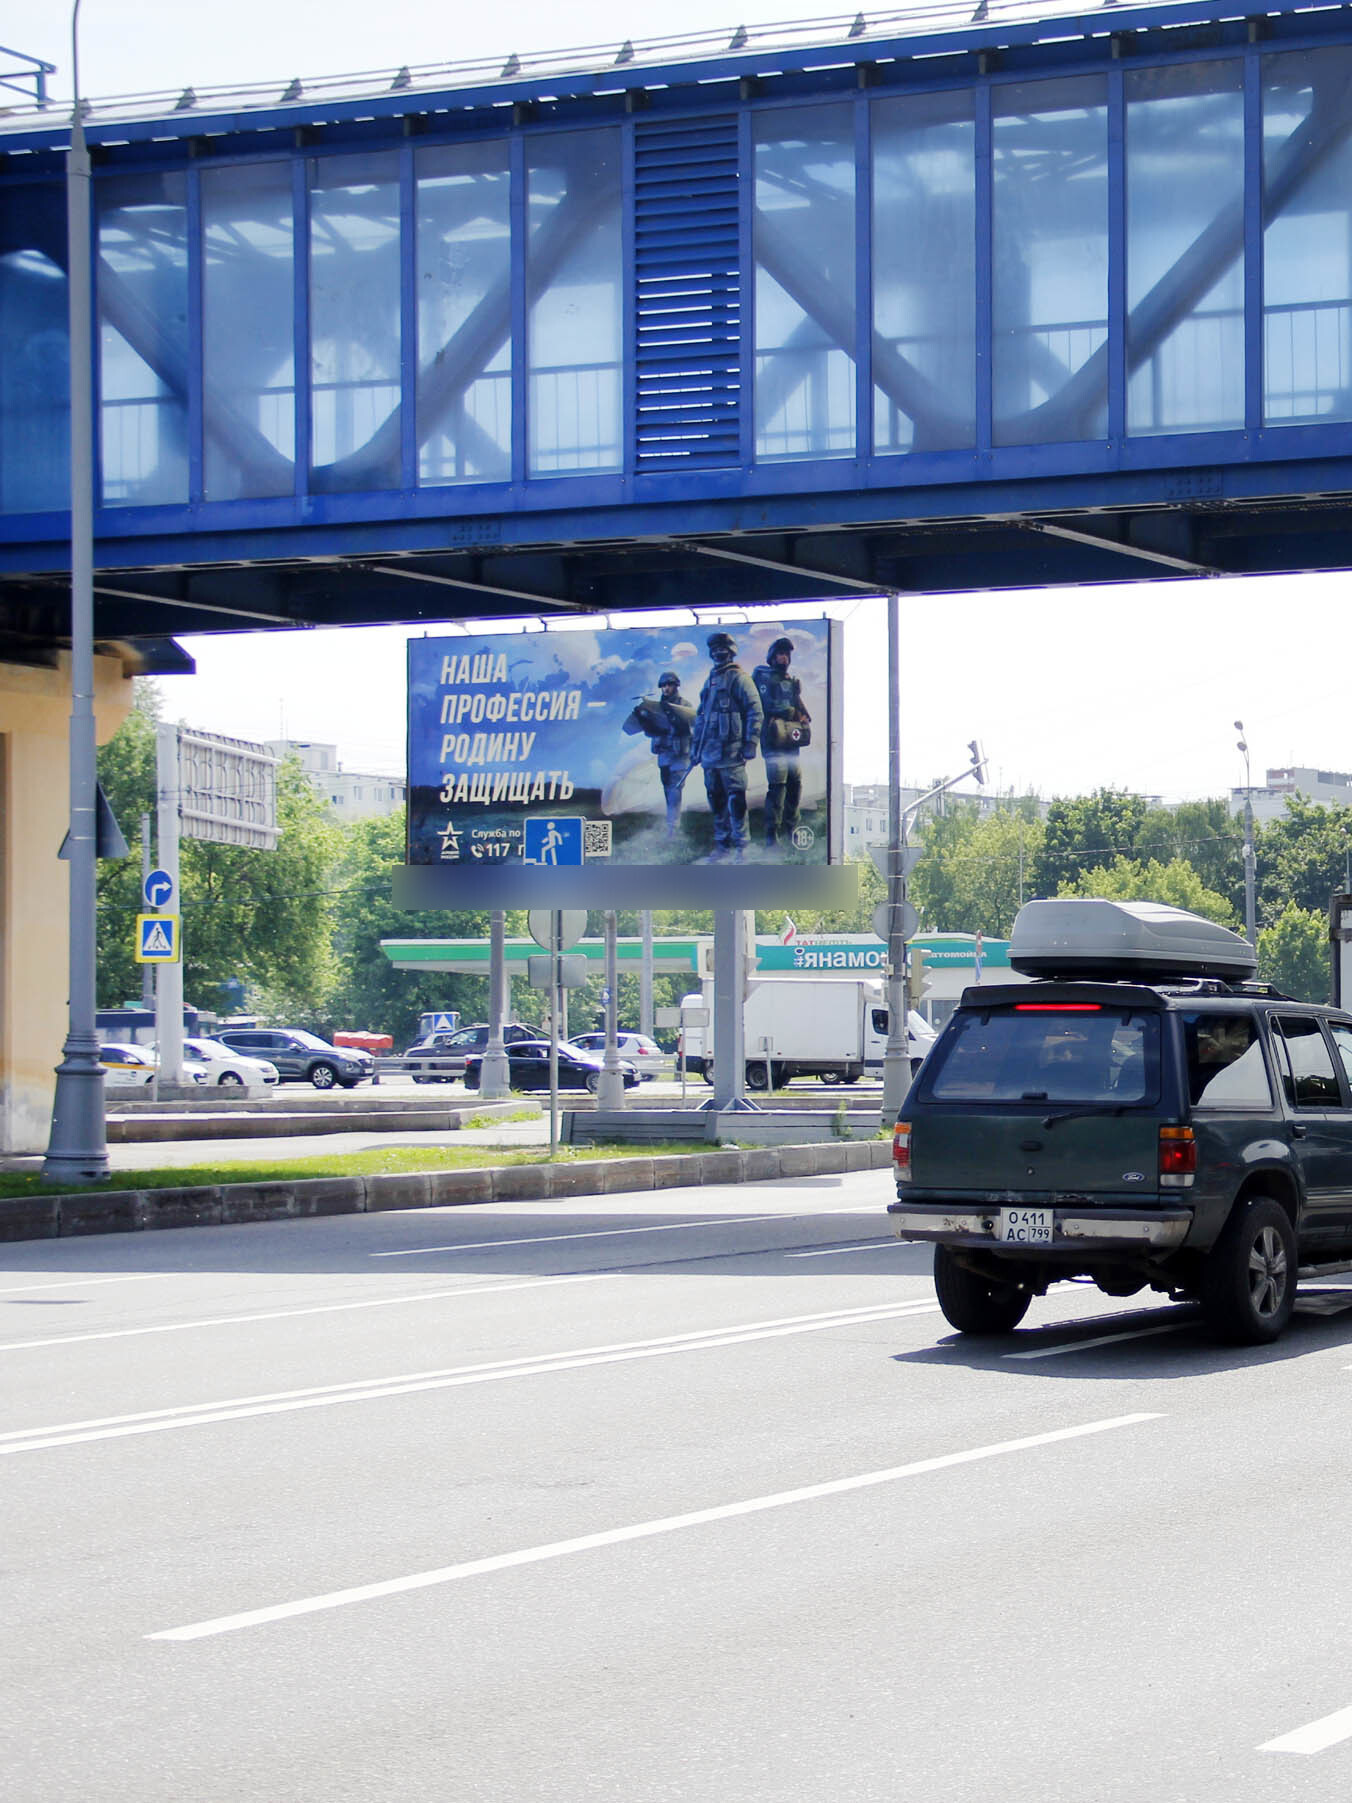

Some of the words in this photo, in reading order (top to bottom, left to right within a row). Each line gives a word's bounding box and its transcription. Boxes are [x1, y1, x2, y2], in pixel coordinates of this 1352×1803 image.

[440, 653, 508, 685] НАША
[440, 690, 582, 724] ПРОФЕССИЯ
[439, 732, 537, 766] РОДИНУ
[439, 770, 575, 806] ЗАЩИЩАТЬ
[471, 828, 507, 841] Служба
[508, 829, 521, 839] по
[796, 830, 813, 846] 18+
[486, 842, 510, 857] 117
[1031, 1228, 1050, 1239] 799
